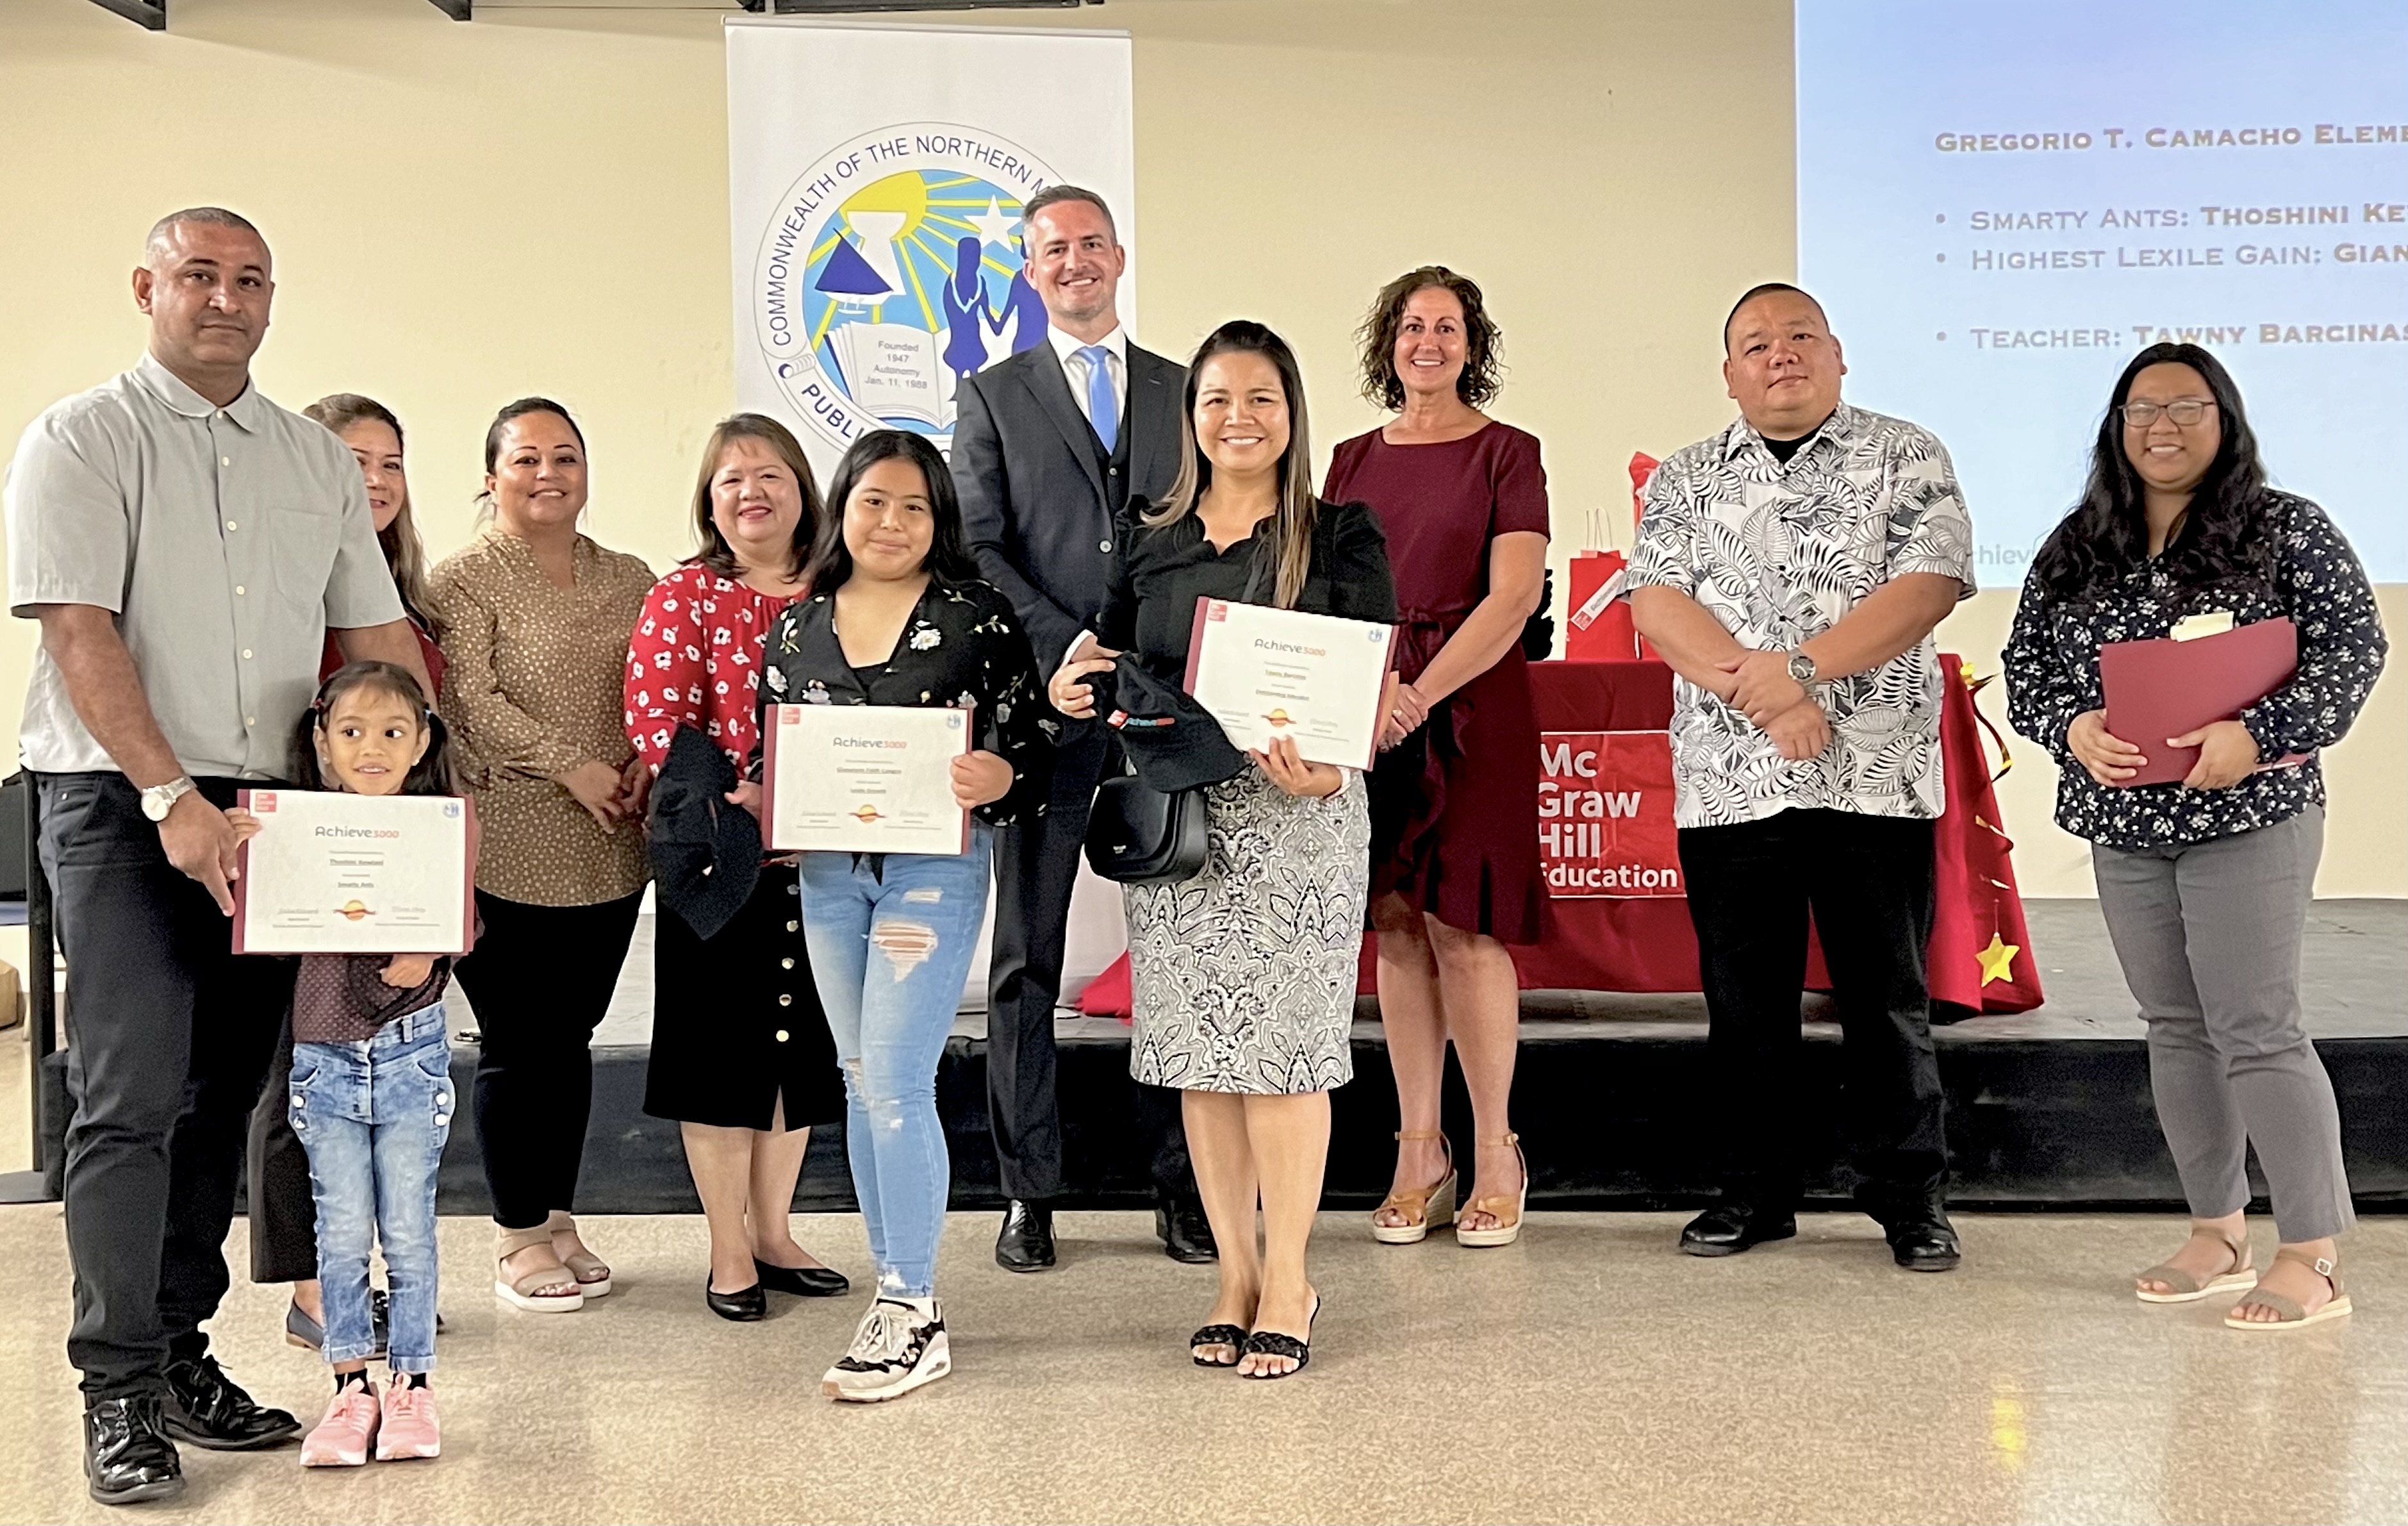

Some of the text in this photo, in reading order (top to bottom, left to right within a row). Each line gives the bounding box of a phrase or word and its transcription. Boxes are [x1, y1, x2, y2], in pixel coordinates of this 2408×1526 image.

[1935, 132, 2093, 152] GREGORIO
[2103, 128, 2134, 149] T.
[2145, 127, 2302, 147] CAMACHO
[1970, 210, 2090, 231] SMARTY
[2099, 208, 2189, 229] ANTS:
[2200, 205, 2350, 226] THOSHINI
[767, 135, 1032, 346] COMMONWEALTH OF THE NORTHERN
[1972, 249, 2107, 270] HIGHEST
[2118, 246, 2223, 267] LEXILE
[2235, 244, 2321, 265] GAIN:
[878, 340, 919, 352] Founded
[1970, 328, 2121, 349] TEACHER:
[2132, 326, 2247, 345] TAWNY
[887, 353, 910, 363] 1947
[801, 383, 864, 444] PUBLI
[1540, 743, 1597, 777] Mc
[1538, 781, 1642, 818] Graw
[315, 825, 400, 838] Achieve3000
[1538, 823, 1600, 858] Hill
